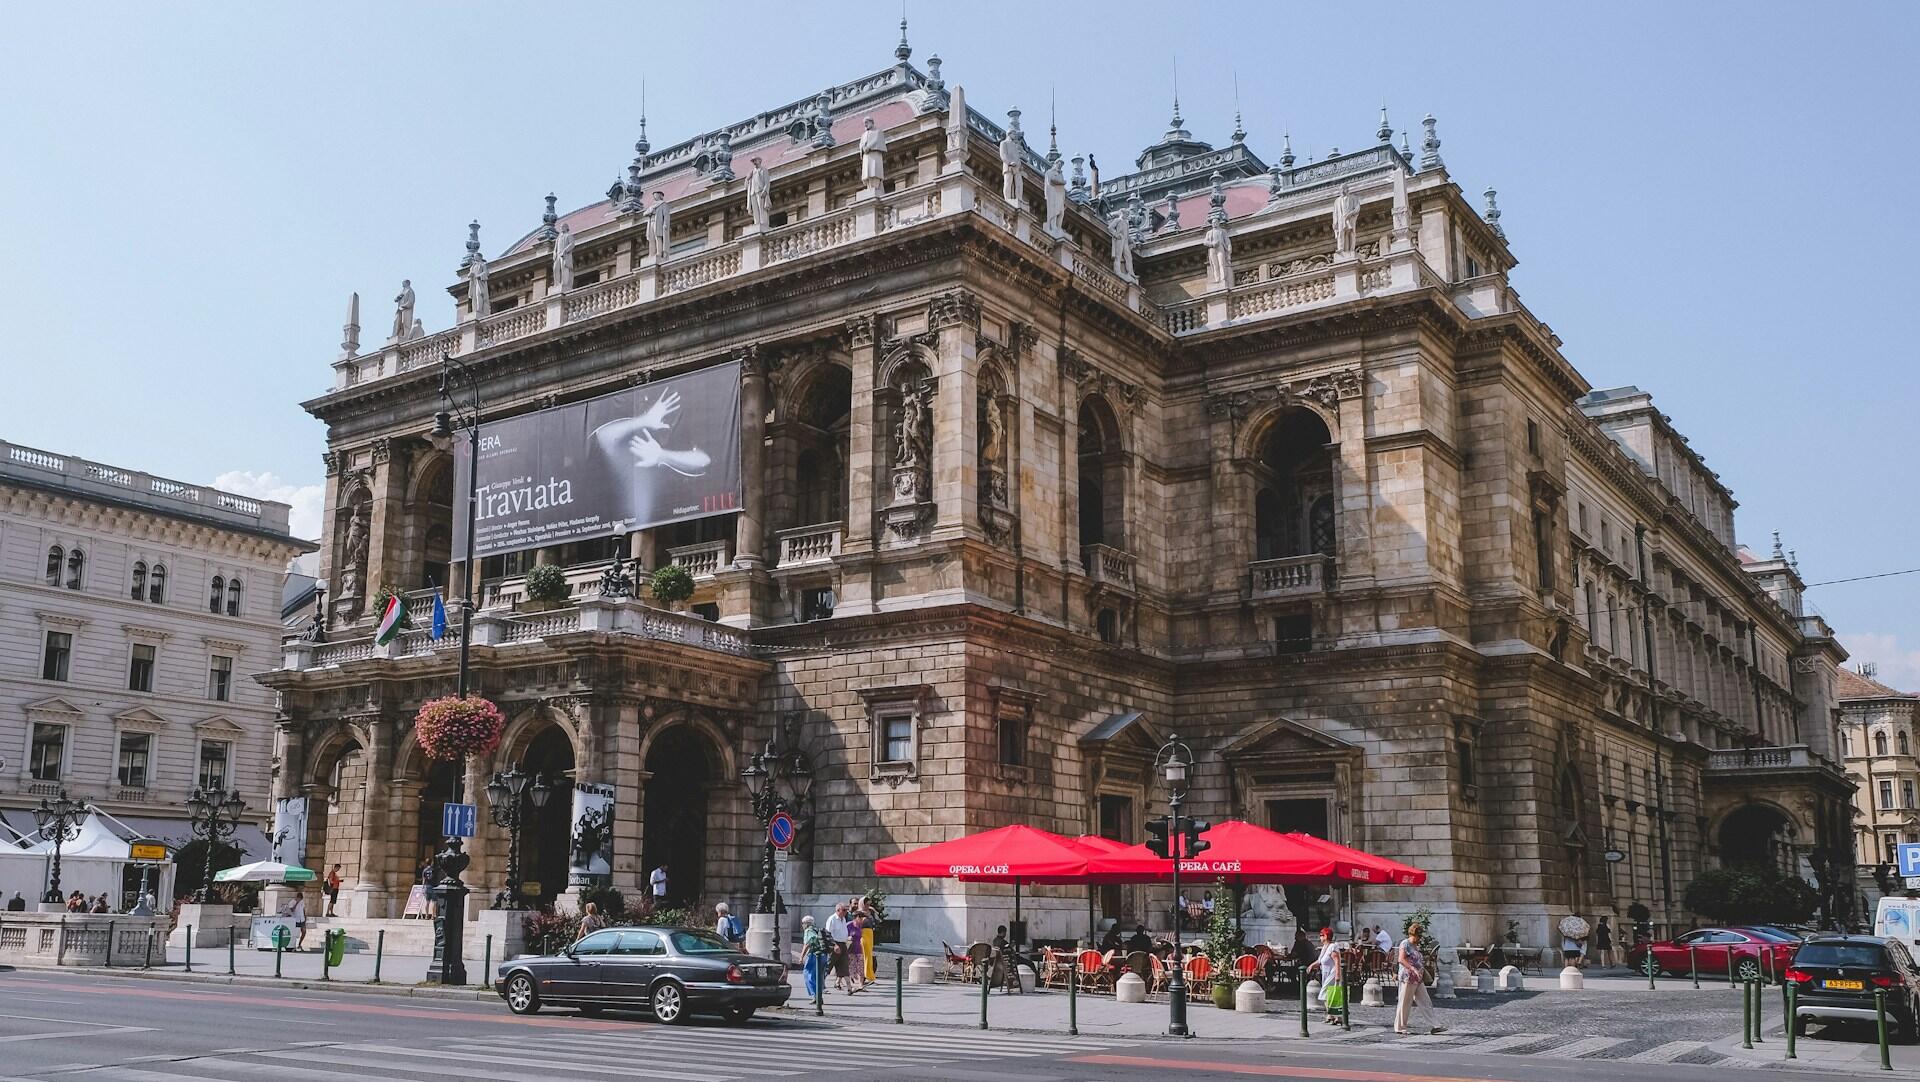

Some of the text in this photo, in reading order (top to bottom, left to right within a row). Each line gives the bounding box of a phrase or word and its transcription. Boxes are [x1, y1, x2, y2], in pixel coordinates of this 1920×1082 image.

[475, 477, 573, 520] Traviata
[949, 865, 980, 874] OPERA
[1173, 861, 1209, 871] PERA
